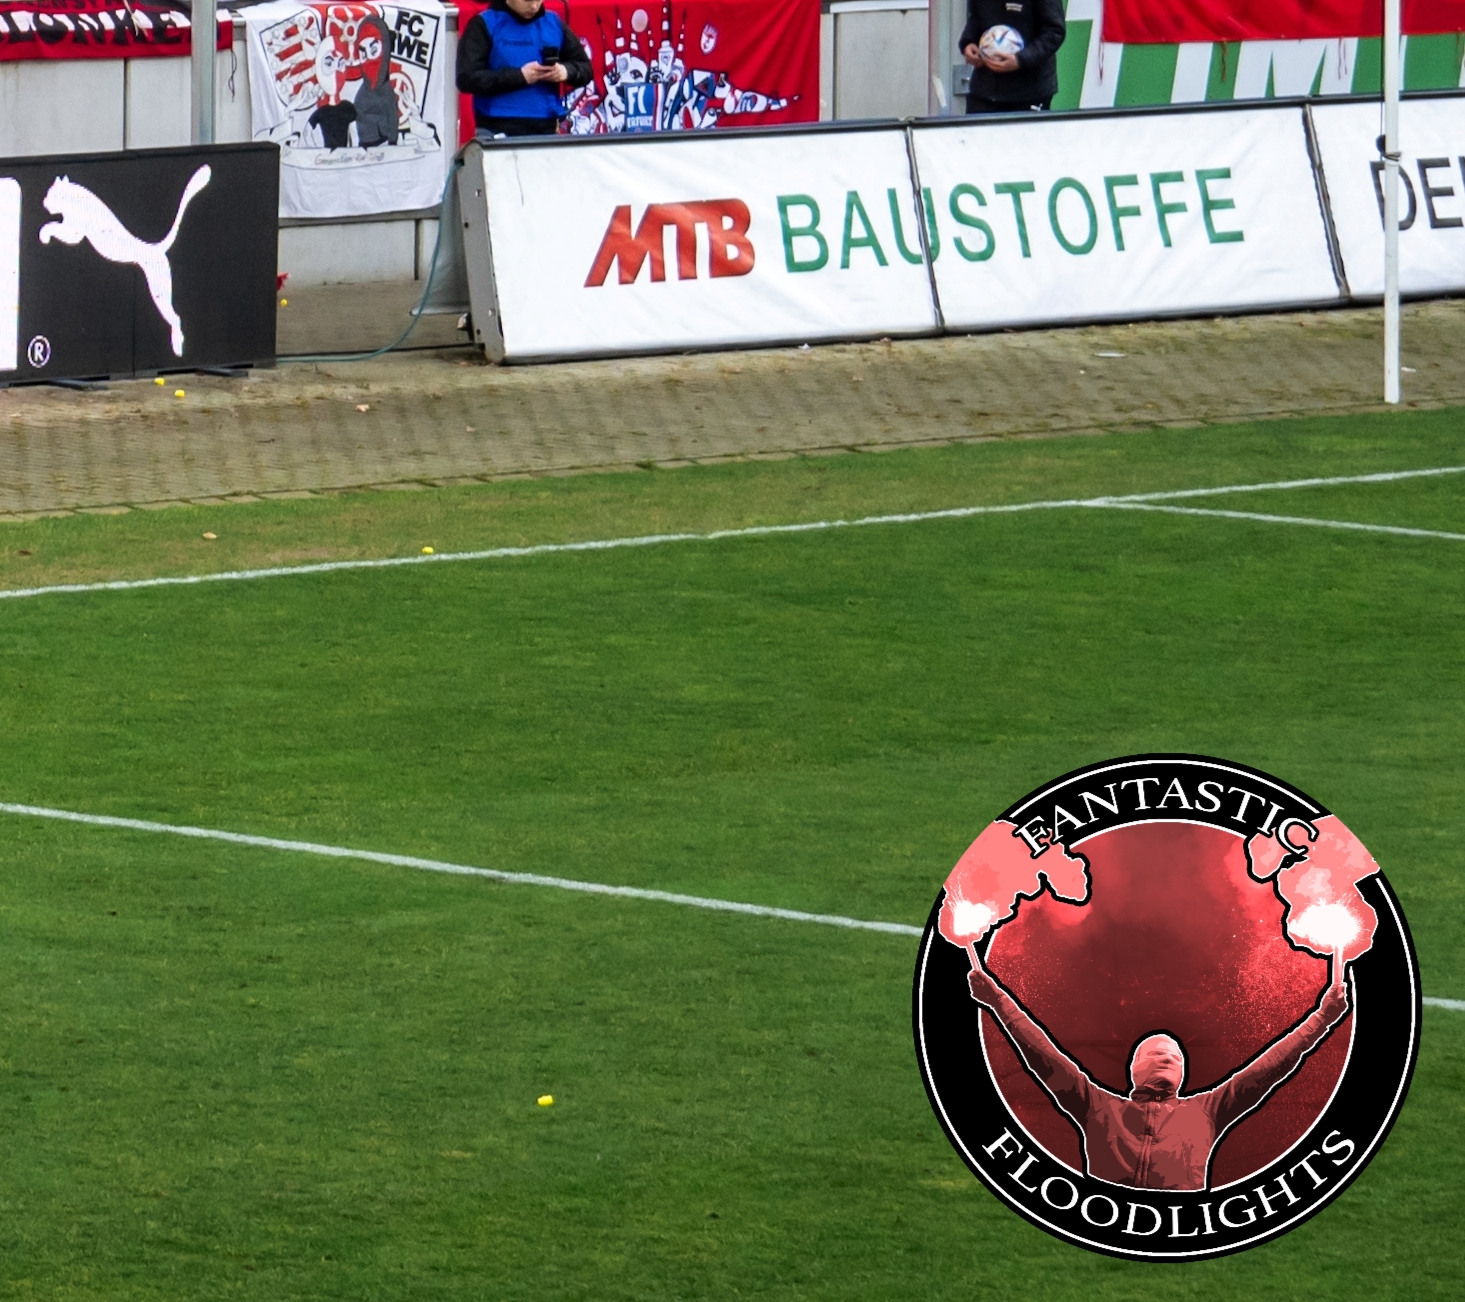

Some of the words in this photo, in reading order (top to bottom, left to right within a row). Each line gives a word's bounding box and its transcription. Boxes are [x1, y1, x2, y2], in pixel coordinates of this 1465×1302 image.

[395, 11, 424, 37] FC
[630, 86, 653, 122] FC
[1370, 155, 1465, 233] DE
[583, 196, 756, 289] MTB
[775, 166, 1246, 275] BAUSTOFFE
